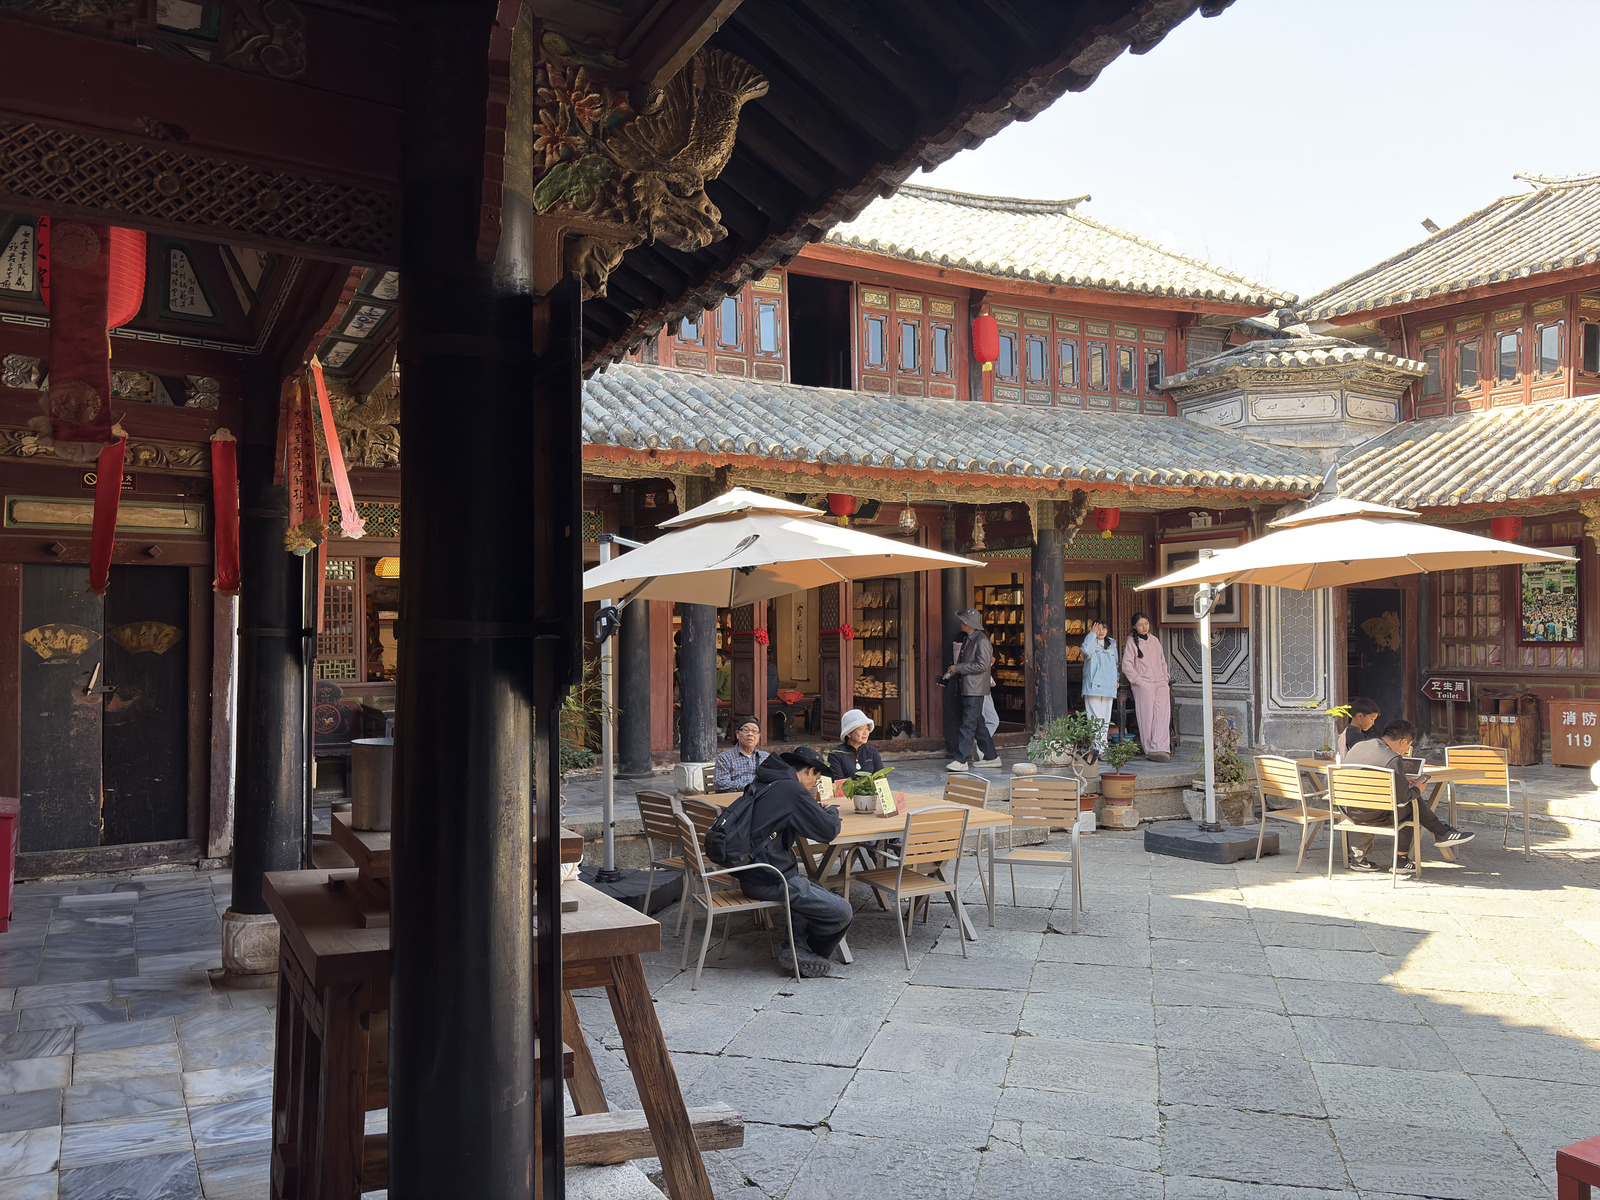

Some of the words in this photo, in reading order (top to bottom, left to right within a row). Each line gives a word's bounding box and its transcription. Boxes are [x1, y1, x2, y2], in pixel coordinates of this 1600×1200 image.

[1431, 681, 1465, 692] 卫生间
[1436, 691, 1459, 699] Toilet
[1562, 711, 1597, 726] 消防
[1566, 733, 1592, 747] 119
